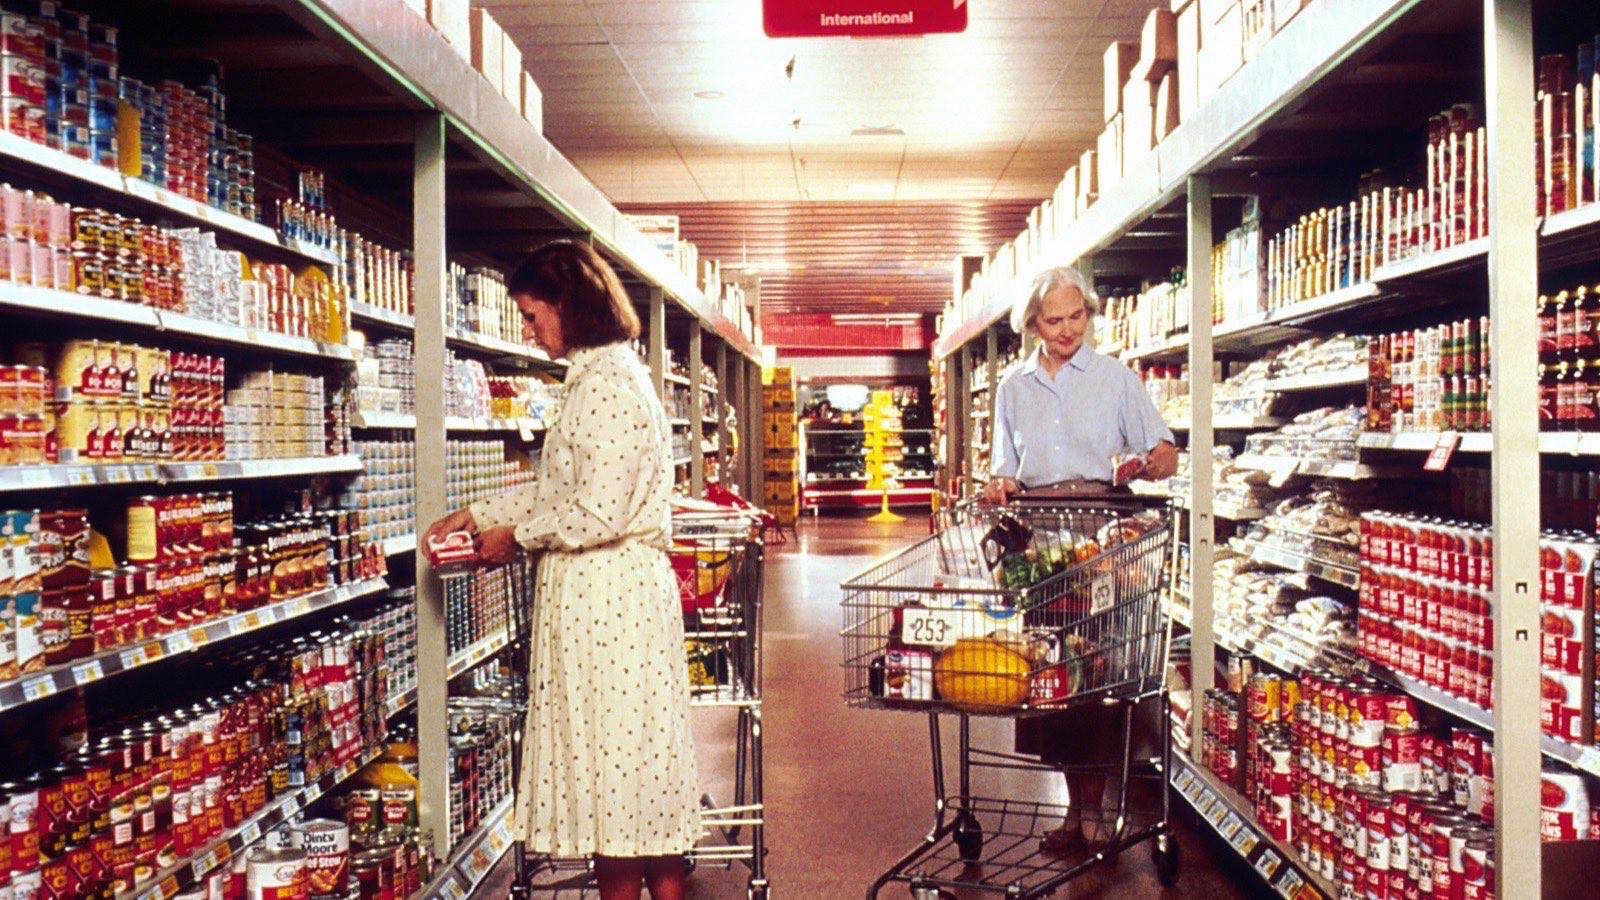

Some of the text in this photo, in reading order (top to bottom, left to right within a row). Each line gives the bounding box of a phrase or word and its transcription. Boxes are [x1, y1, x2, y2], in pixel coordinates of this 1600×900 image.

[820, 11, 914, 27] International
[914, 618, 945, 642] 253
[303, 833, 335, 844] Dinty
[300, 844, 338, 853] Moore
